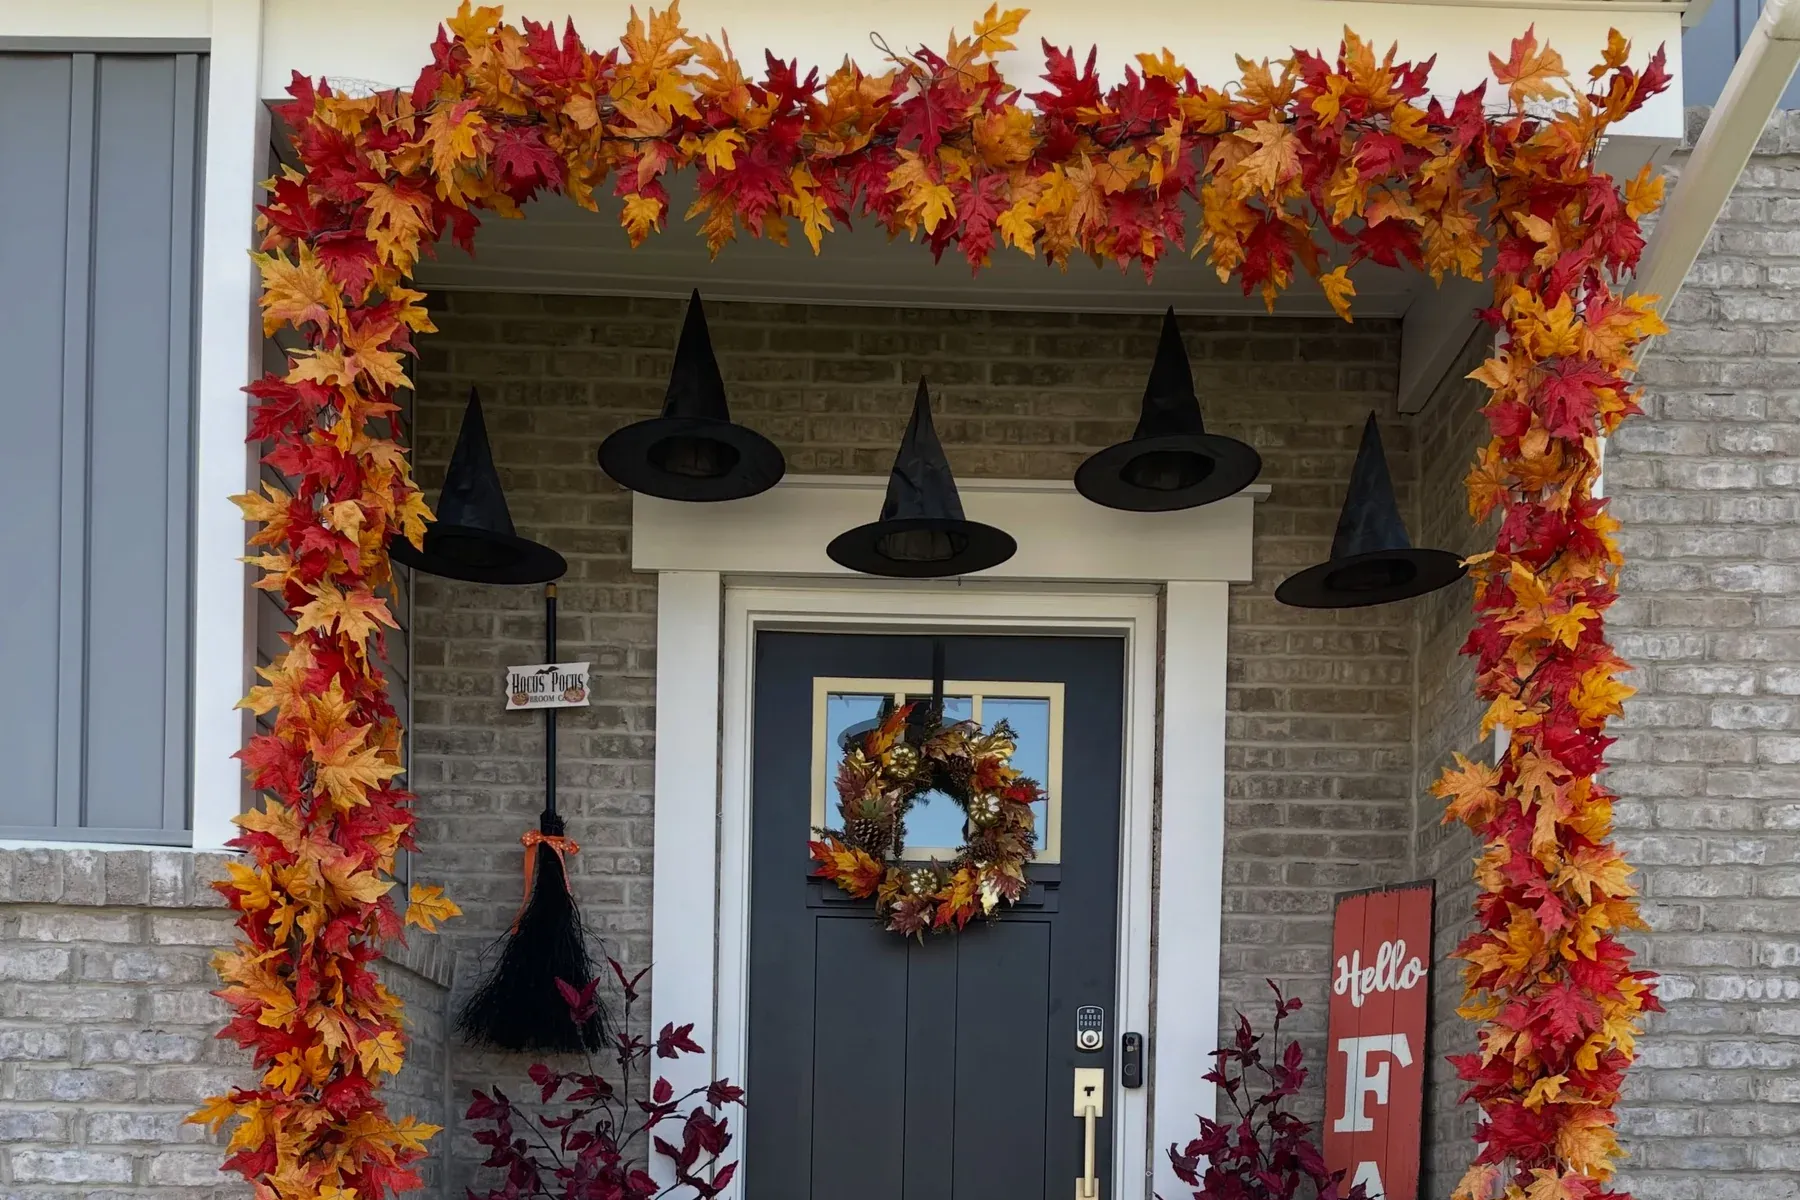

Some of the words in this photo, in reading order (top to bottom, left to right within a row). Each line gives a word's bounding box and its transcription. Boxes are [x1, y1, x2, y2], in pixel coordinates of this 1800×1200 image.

[512, 673, 545, 694] HOCUS
[551, 671, 584, 692] POCUS
[529, 695, 555, 703] BROOM
[1333, 939, 1428, 1008] Hello
